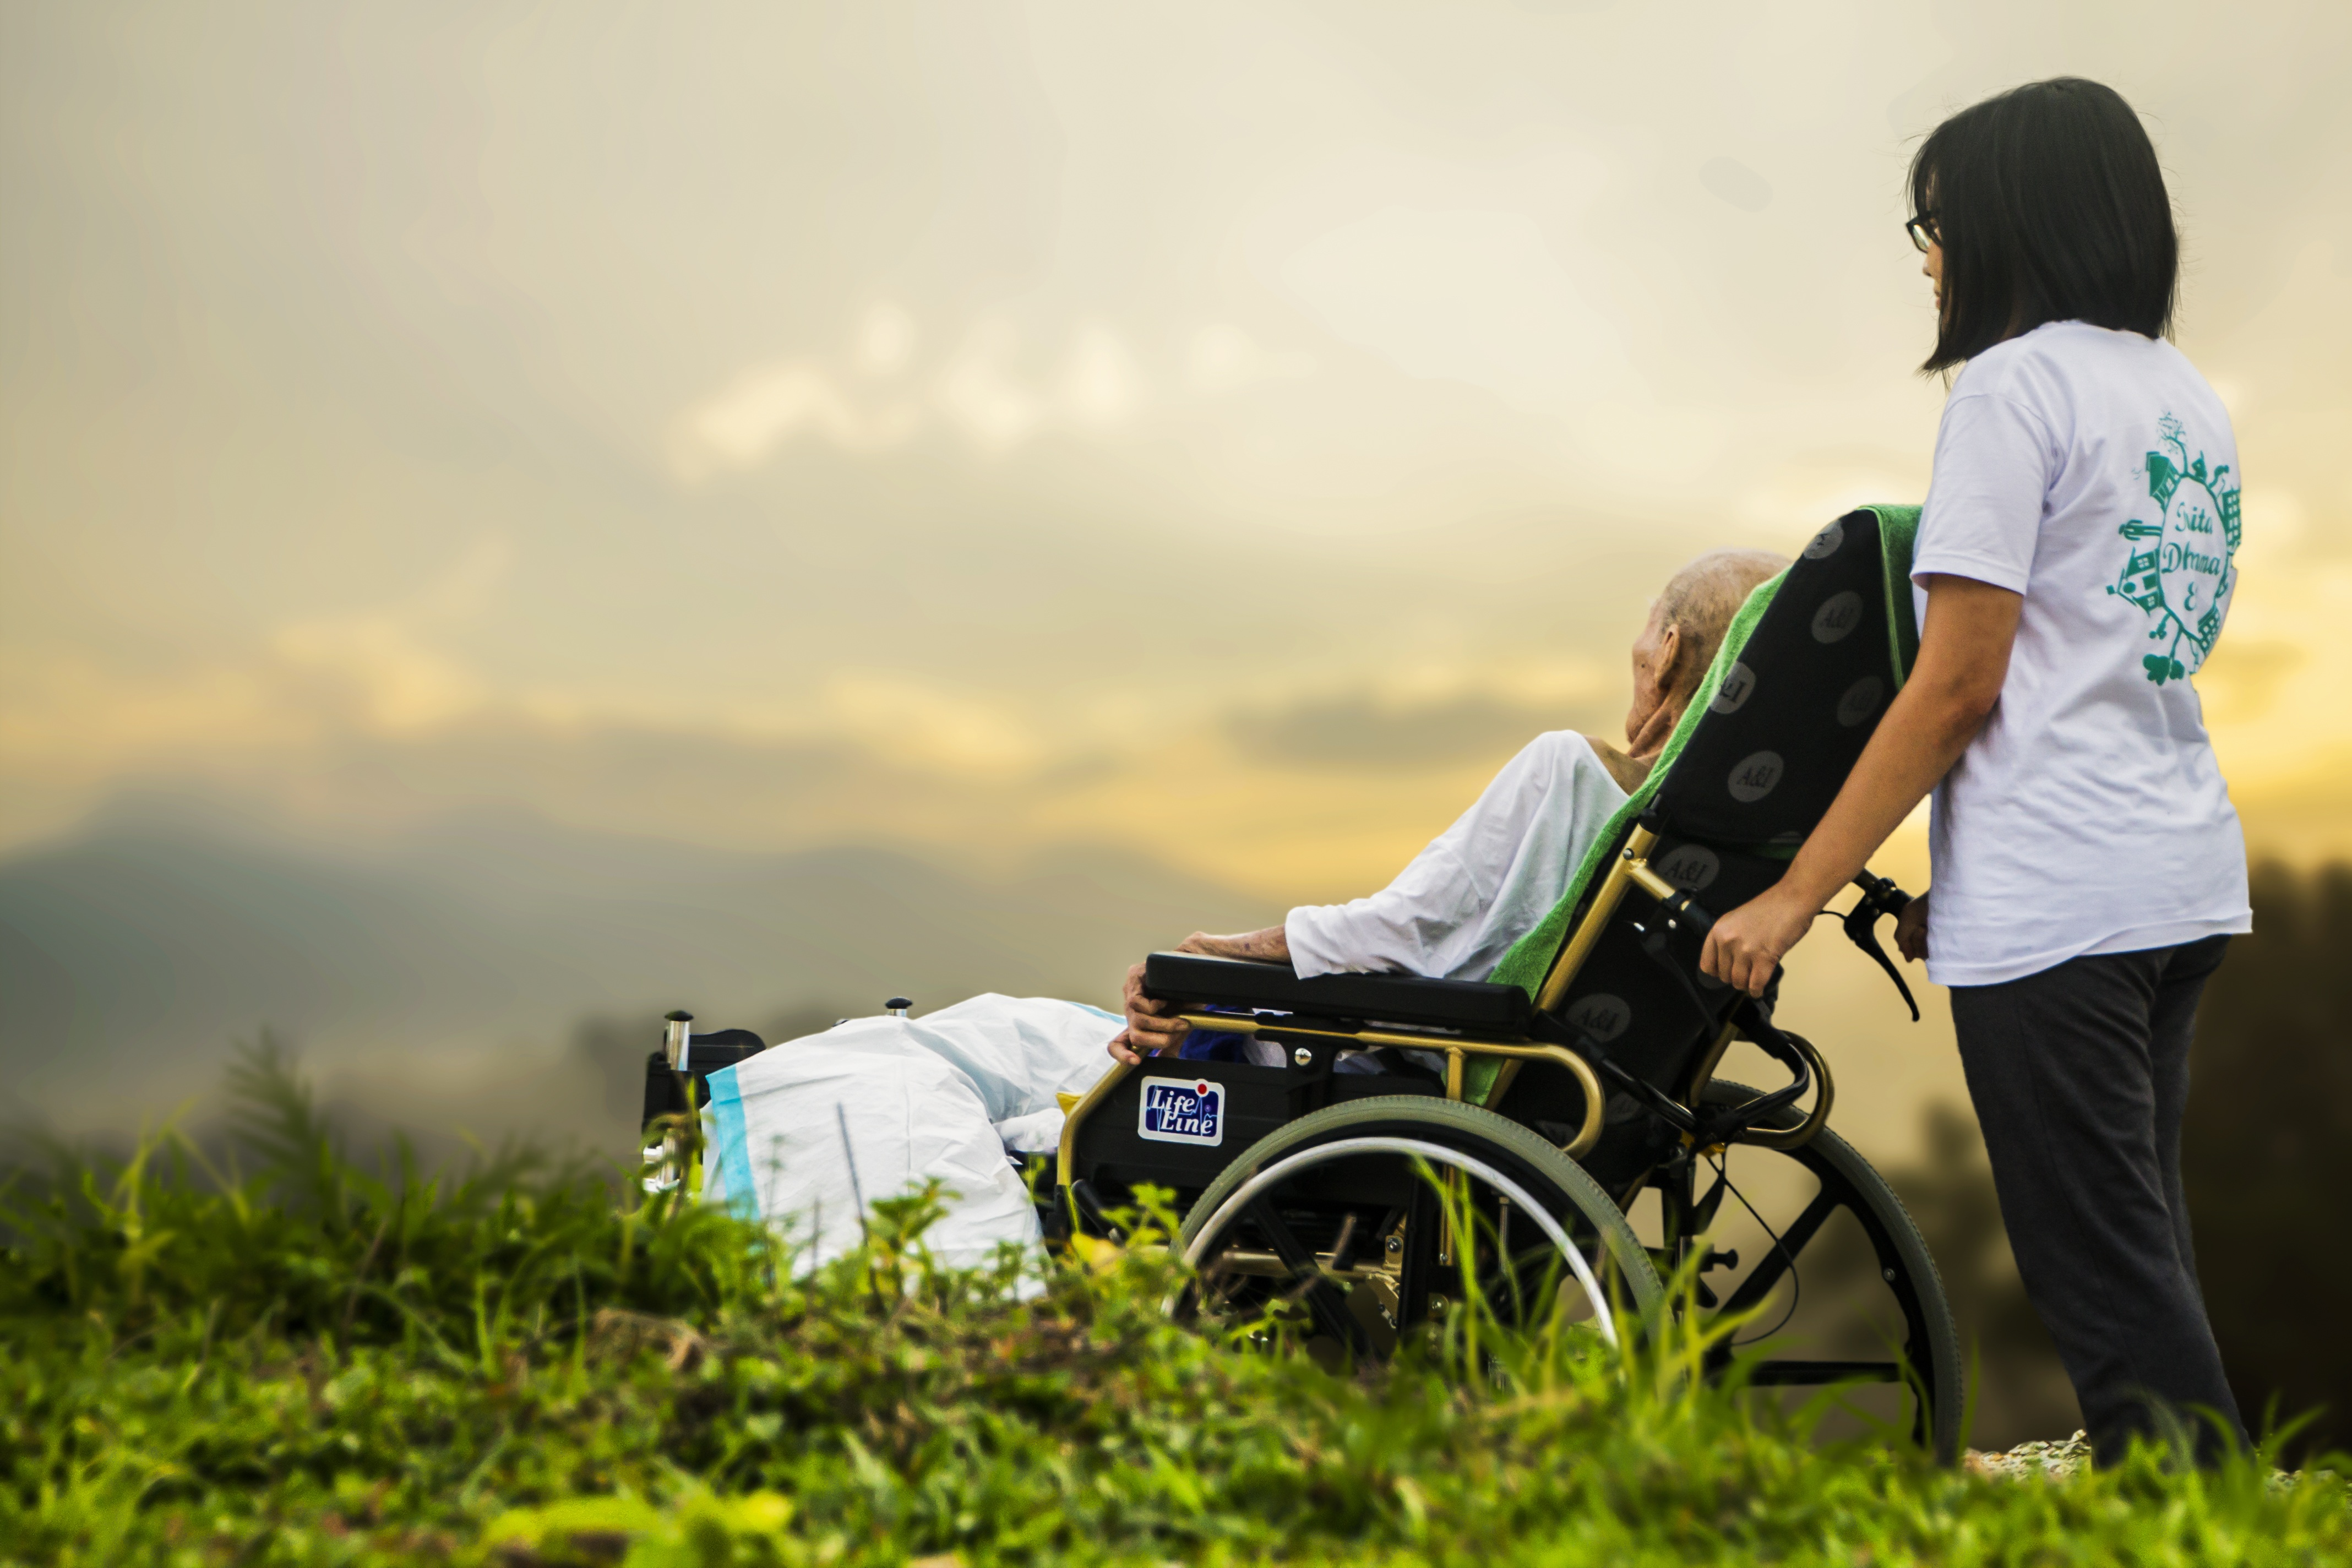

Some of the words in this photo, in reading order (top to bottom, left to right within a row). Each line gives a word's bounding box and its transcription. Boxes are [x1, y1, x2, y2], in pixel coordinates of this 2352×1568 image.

[1737, 765, 1775, 788] A&I
[1664, 857, 1708, 884] A&I
[1151, 1090, 1195, 1120] Life
[1161, 1110, 1213, 1134] Line
